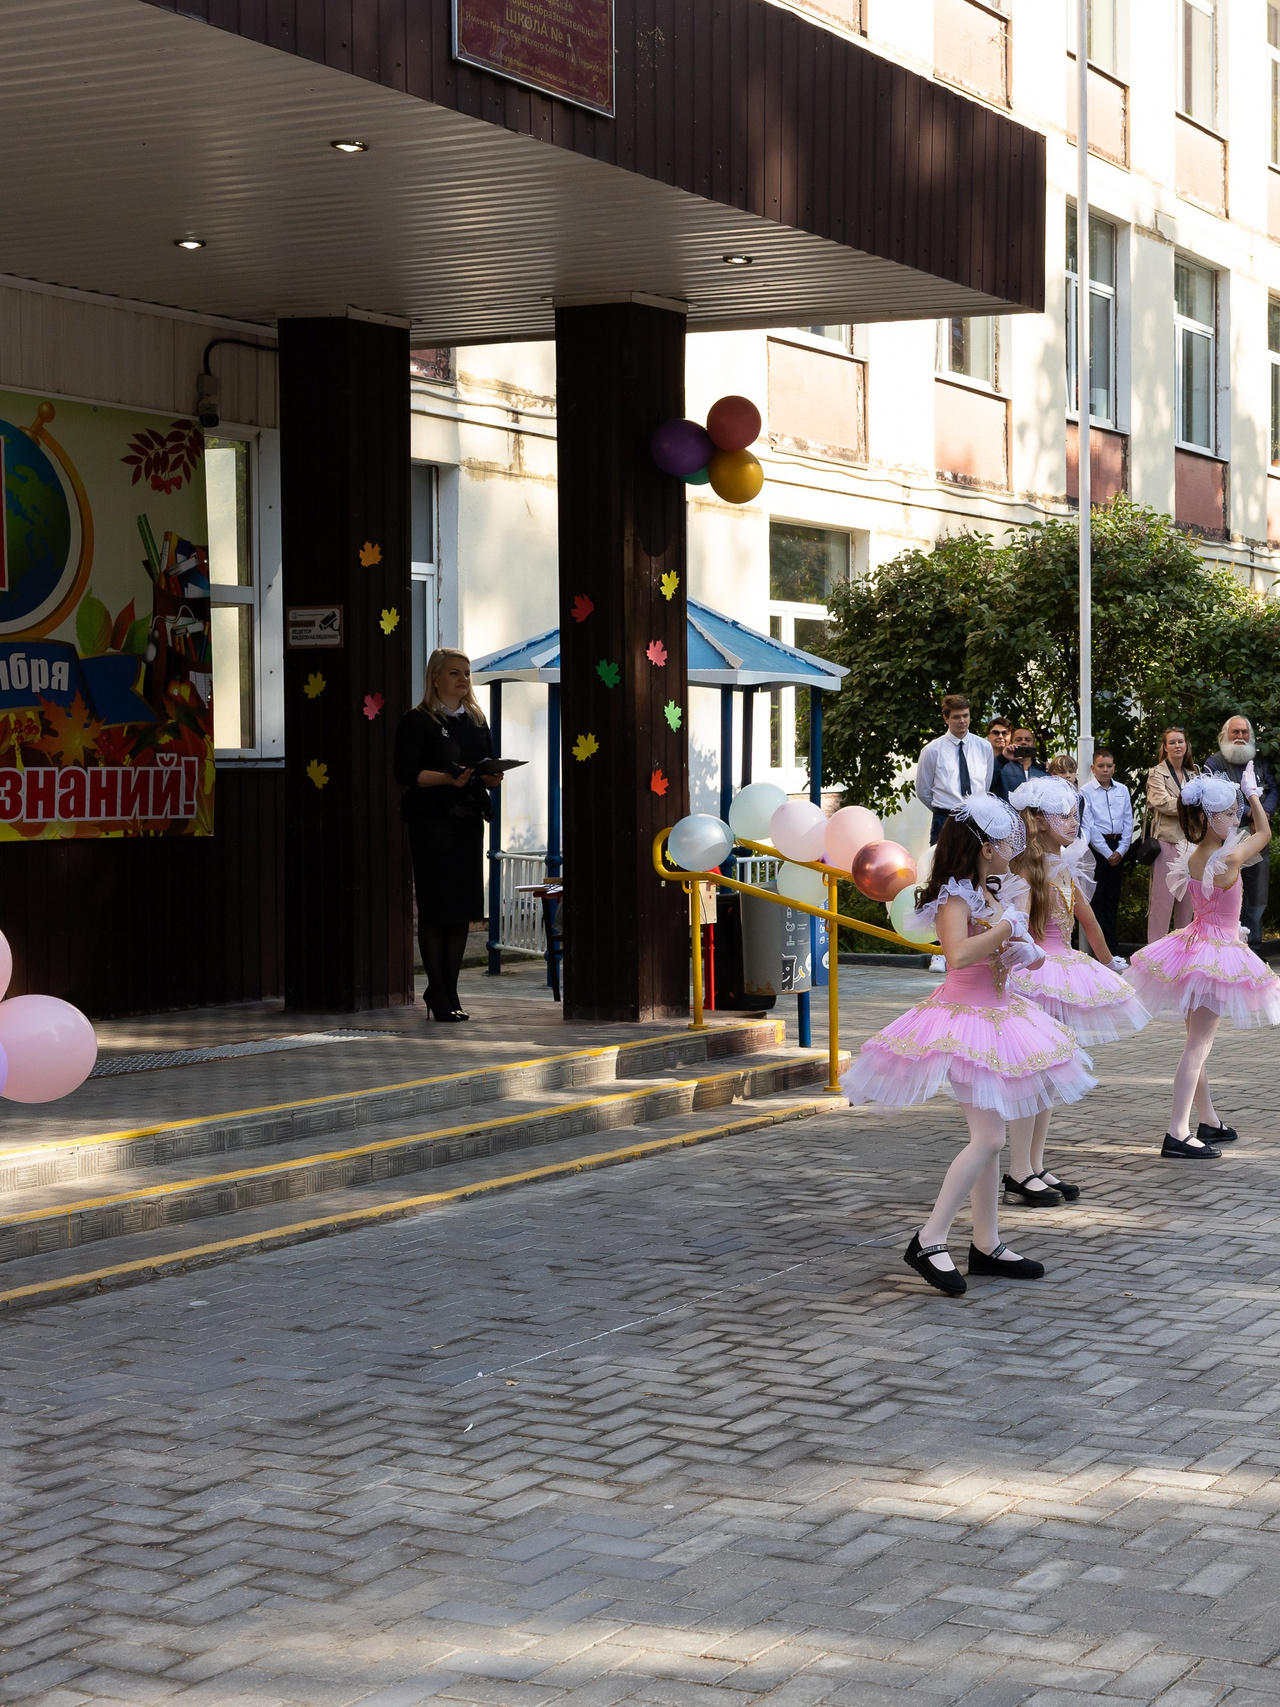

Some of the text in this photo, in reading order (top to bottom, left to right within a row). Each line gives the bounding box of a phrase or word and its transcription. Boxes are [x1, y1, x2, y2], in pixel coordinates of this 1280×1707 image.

[505, 7, 573, 48] ШКОЛА № 1
[545, 43, 565, 58] Союза
[0, 752, 198, 822] знаний!
